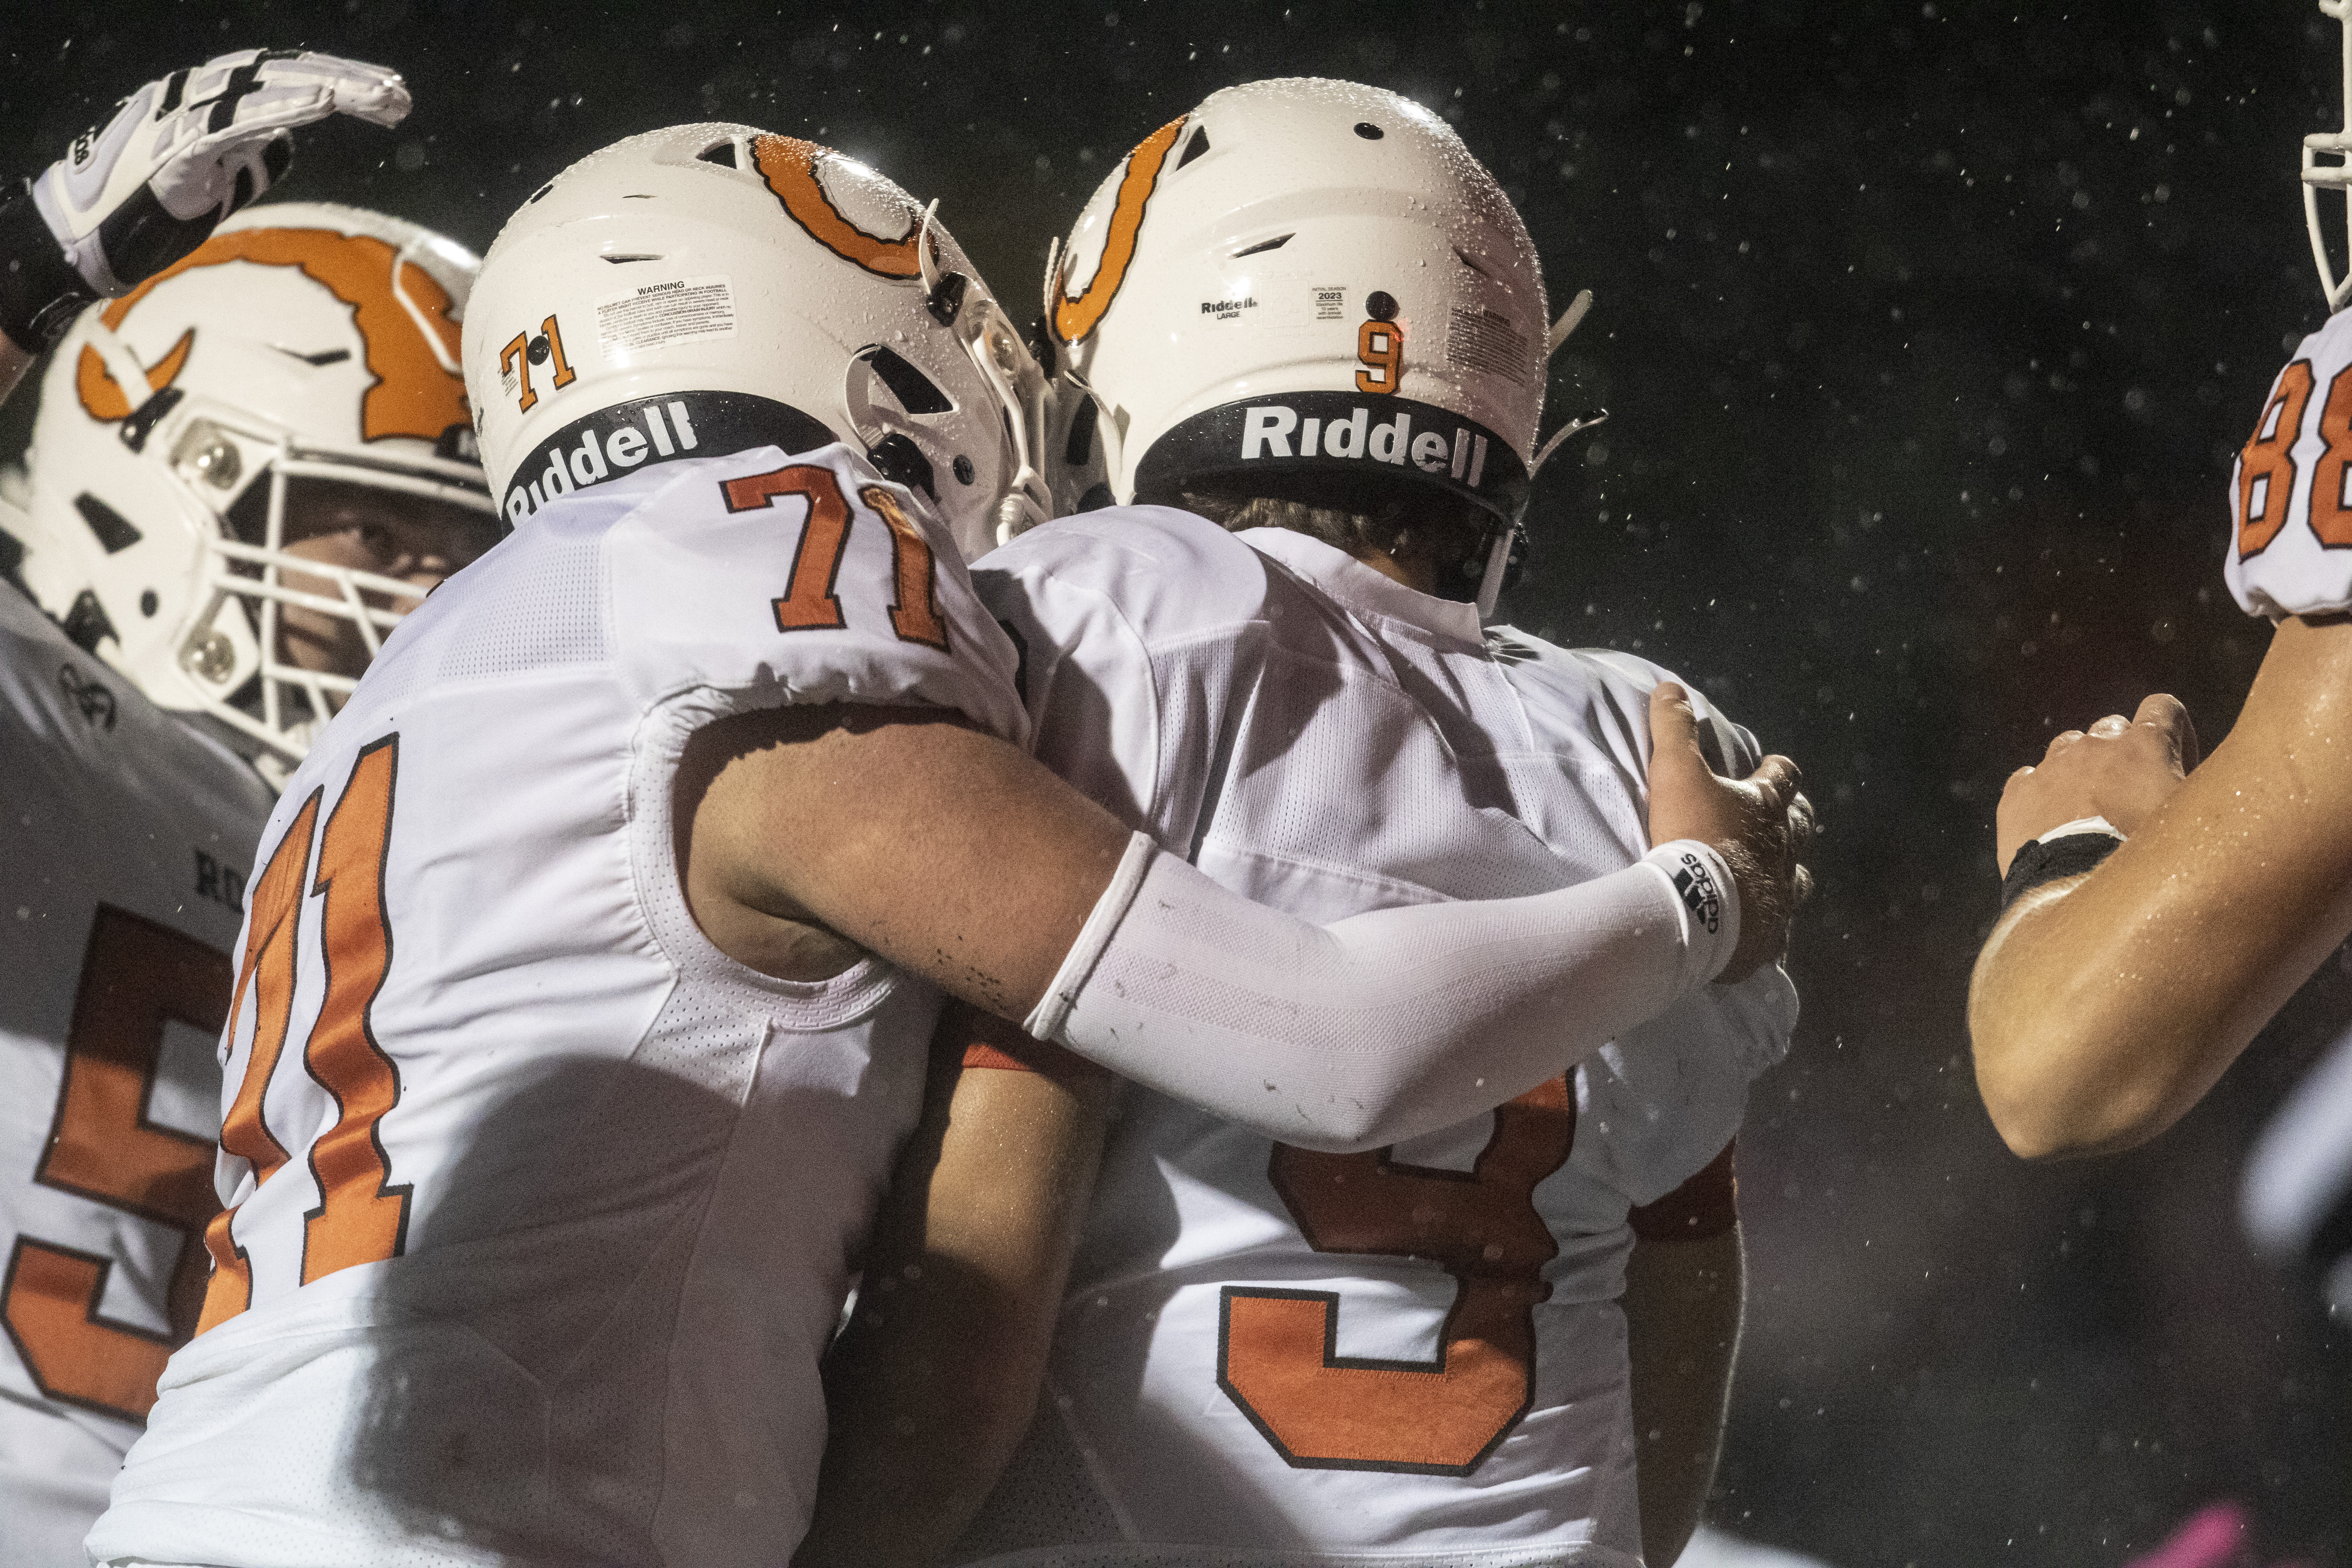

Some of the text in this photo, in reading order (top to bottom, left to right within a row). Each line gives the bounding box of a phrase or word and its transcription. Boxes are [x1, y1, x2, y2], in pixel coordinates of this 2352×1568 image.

[638, 281, 684, 295] WARNING
[1201, 297, 1252, 314] Riddell
[1217, 311, 1240, 319] LARGE
[500, 314, 577, 415] 71
[1356, 319, 1403, 396] 9
[504, 401, 698, 530] Riddell
[1241, 405, 1488, 488] Riddell
[719, 463, 951, 654] 71
[1681, 853, 1719, 934] adidas
[1216, 1065, 1578, 1477] 9
